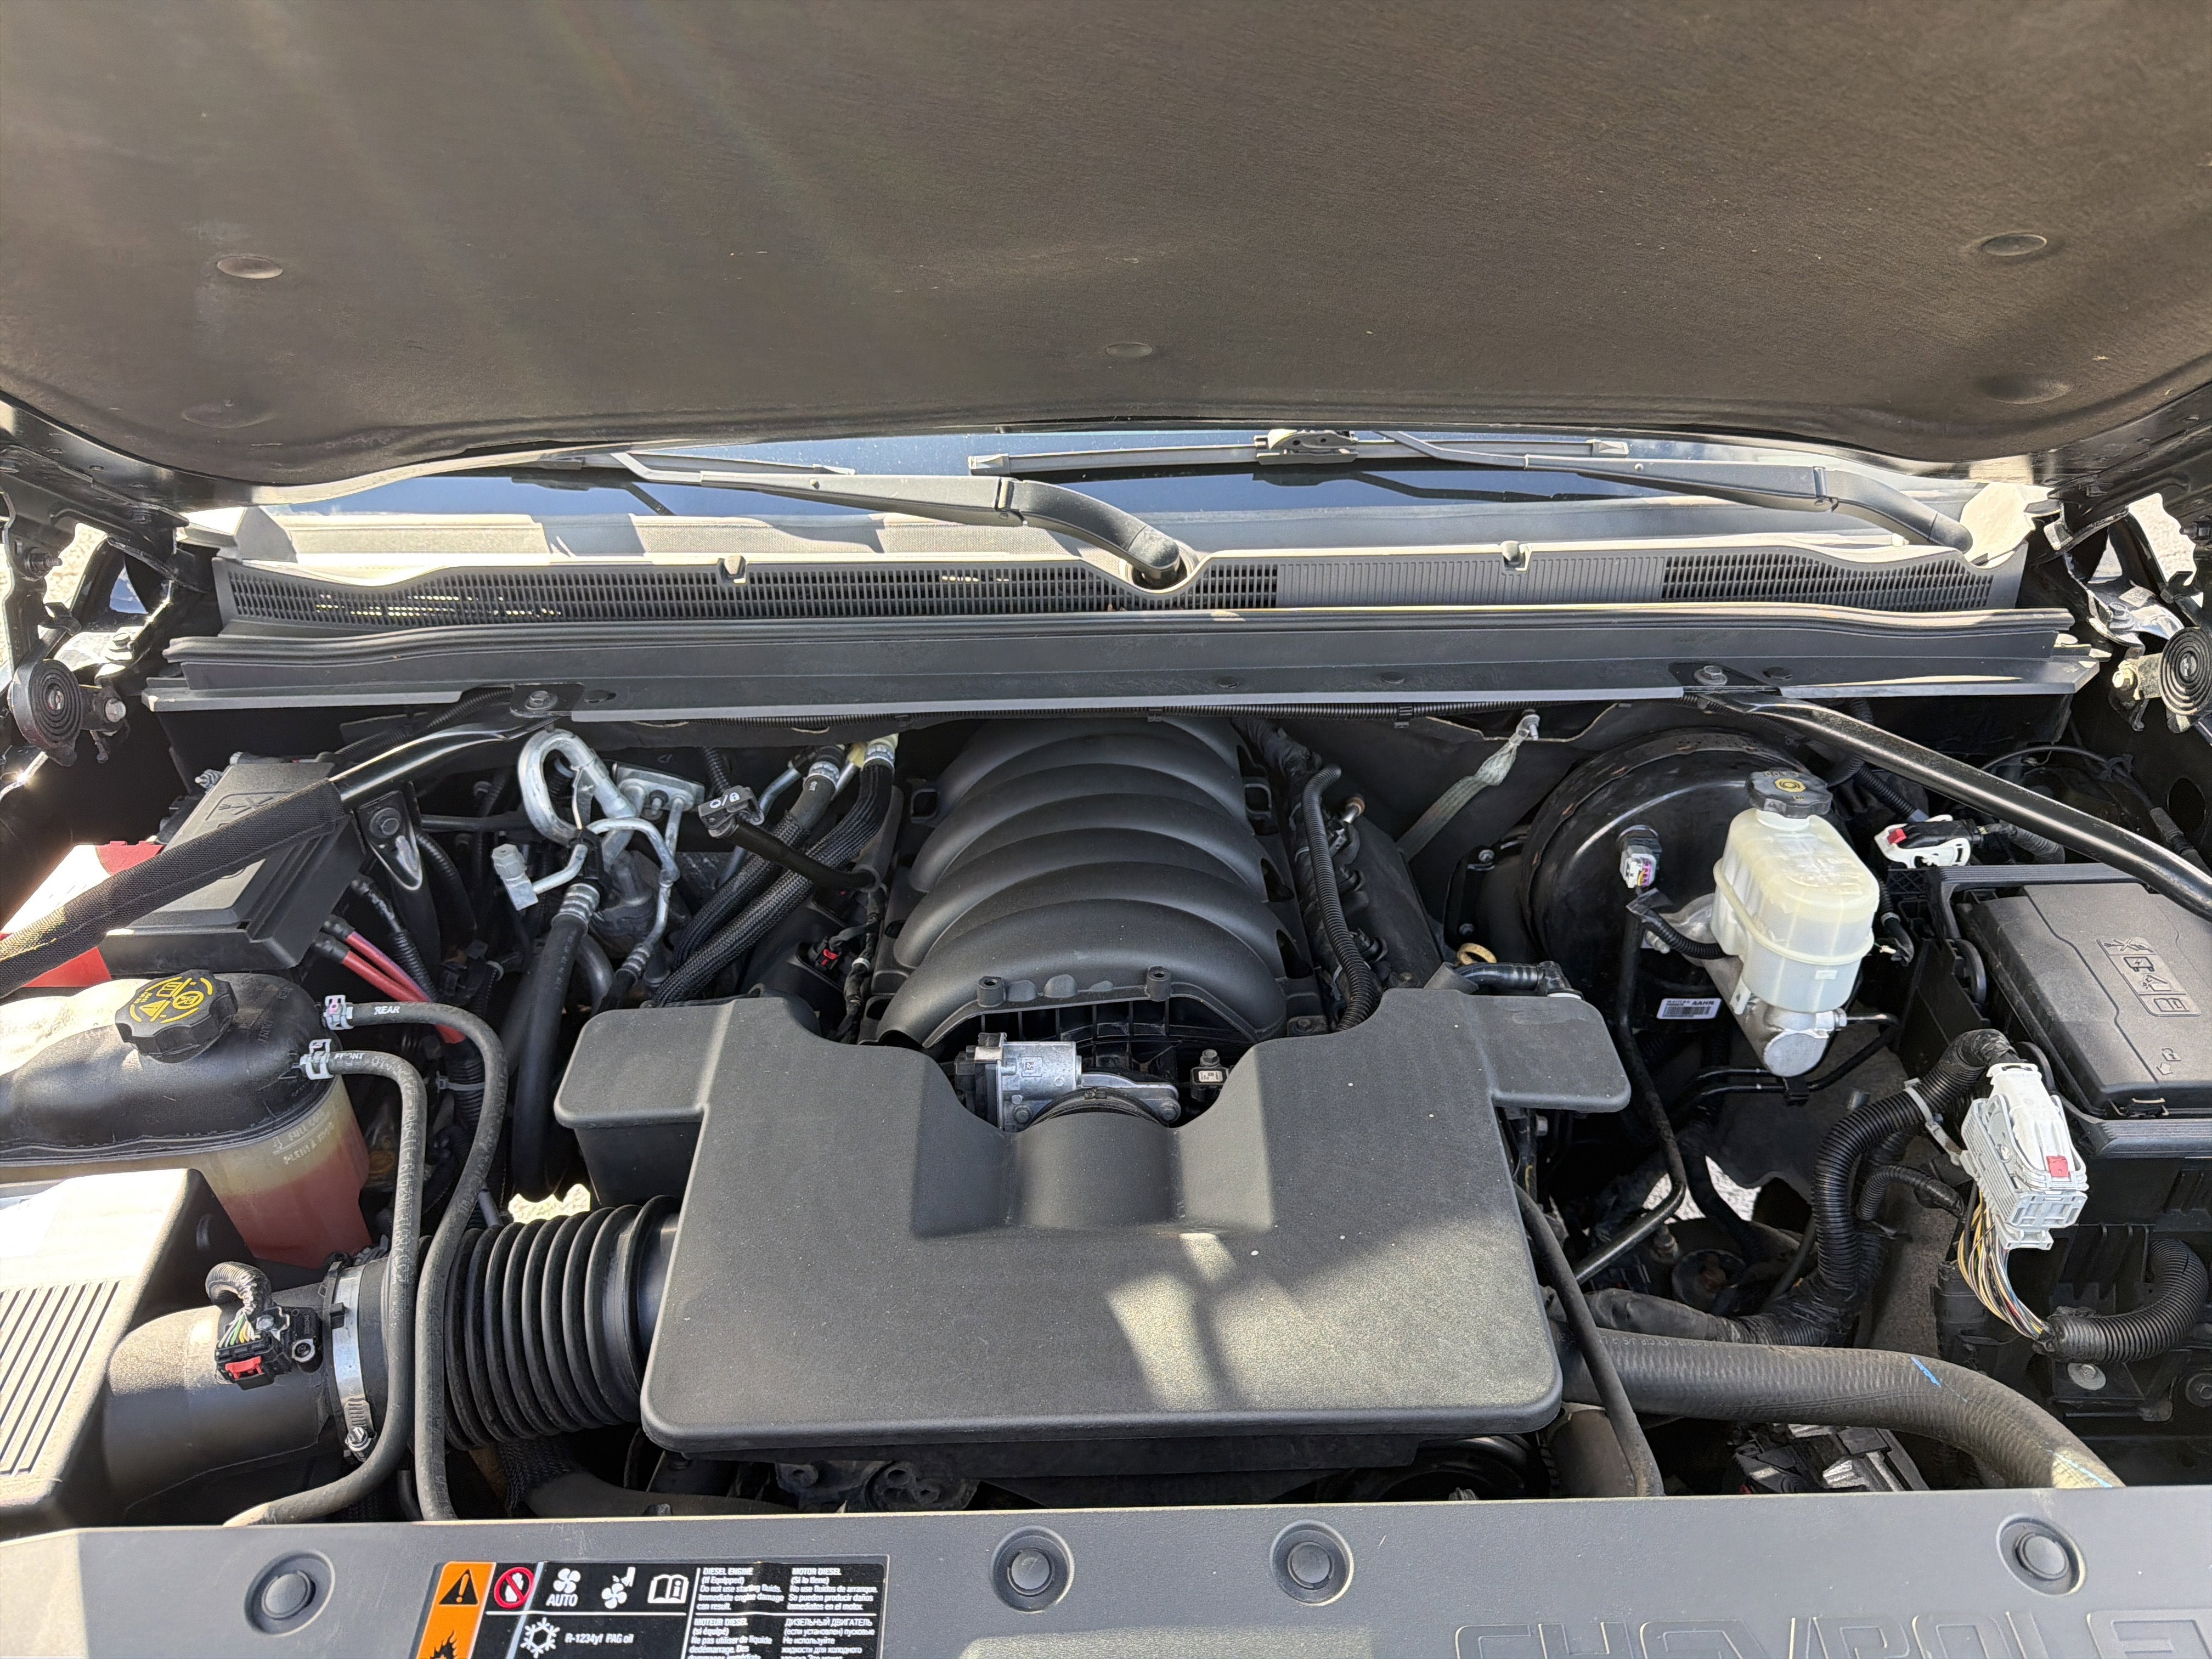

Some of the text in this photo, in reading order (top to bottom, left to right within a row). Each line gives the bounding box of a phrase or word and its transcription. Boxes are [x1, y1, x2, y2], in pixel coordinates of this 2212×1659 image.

[374, 1006, 400, 1015] REAR
[817, 1567, 842, 1576] DIESEL
[710, 1576, 744, 1585] Equipped)
[810, 1576, 830, 1585] tiene)
[736, 1584, 760, 1593] starting
[545, 1593, 578, 1606] AUTO
[734, 1593, 756, 1602] engine
[757, 1593, 785, 1602] damage
[798, 1594, 823, 1602] pueden
[824, 1594, 852, 1602] producir
[693, 1618, 748, 1626] MOTEUR DIESEL
[785, 1617, 873, 1627] ДИЗЕЛЬНЫЙ ДВИГАТЕЛЬ
[565, 1633, 634, 1645] R-1234yf PAG oil
[691, 1636, 701, 1644] Ne
[702, 1637, 714, 1645] pas
